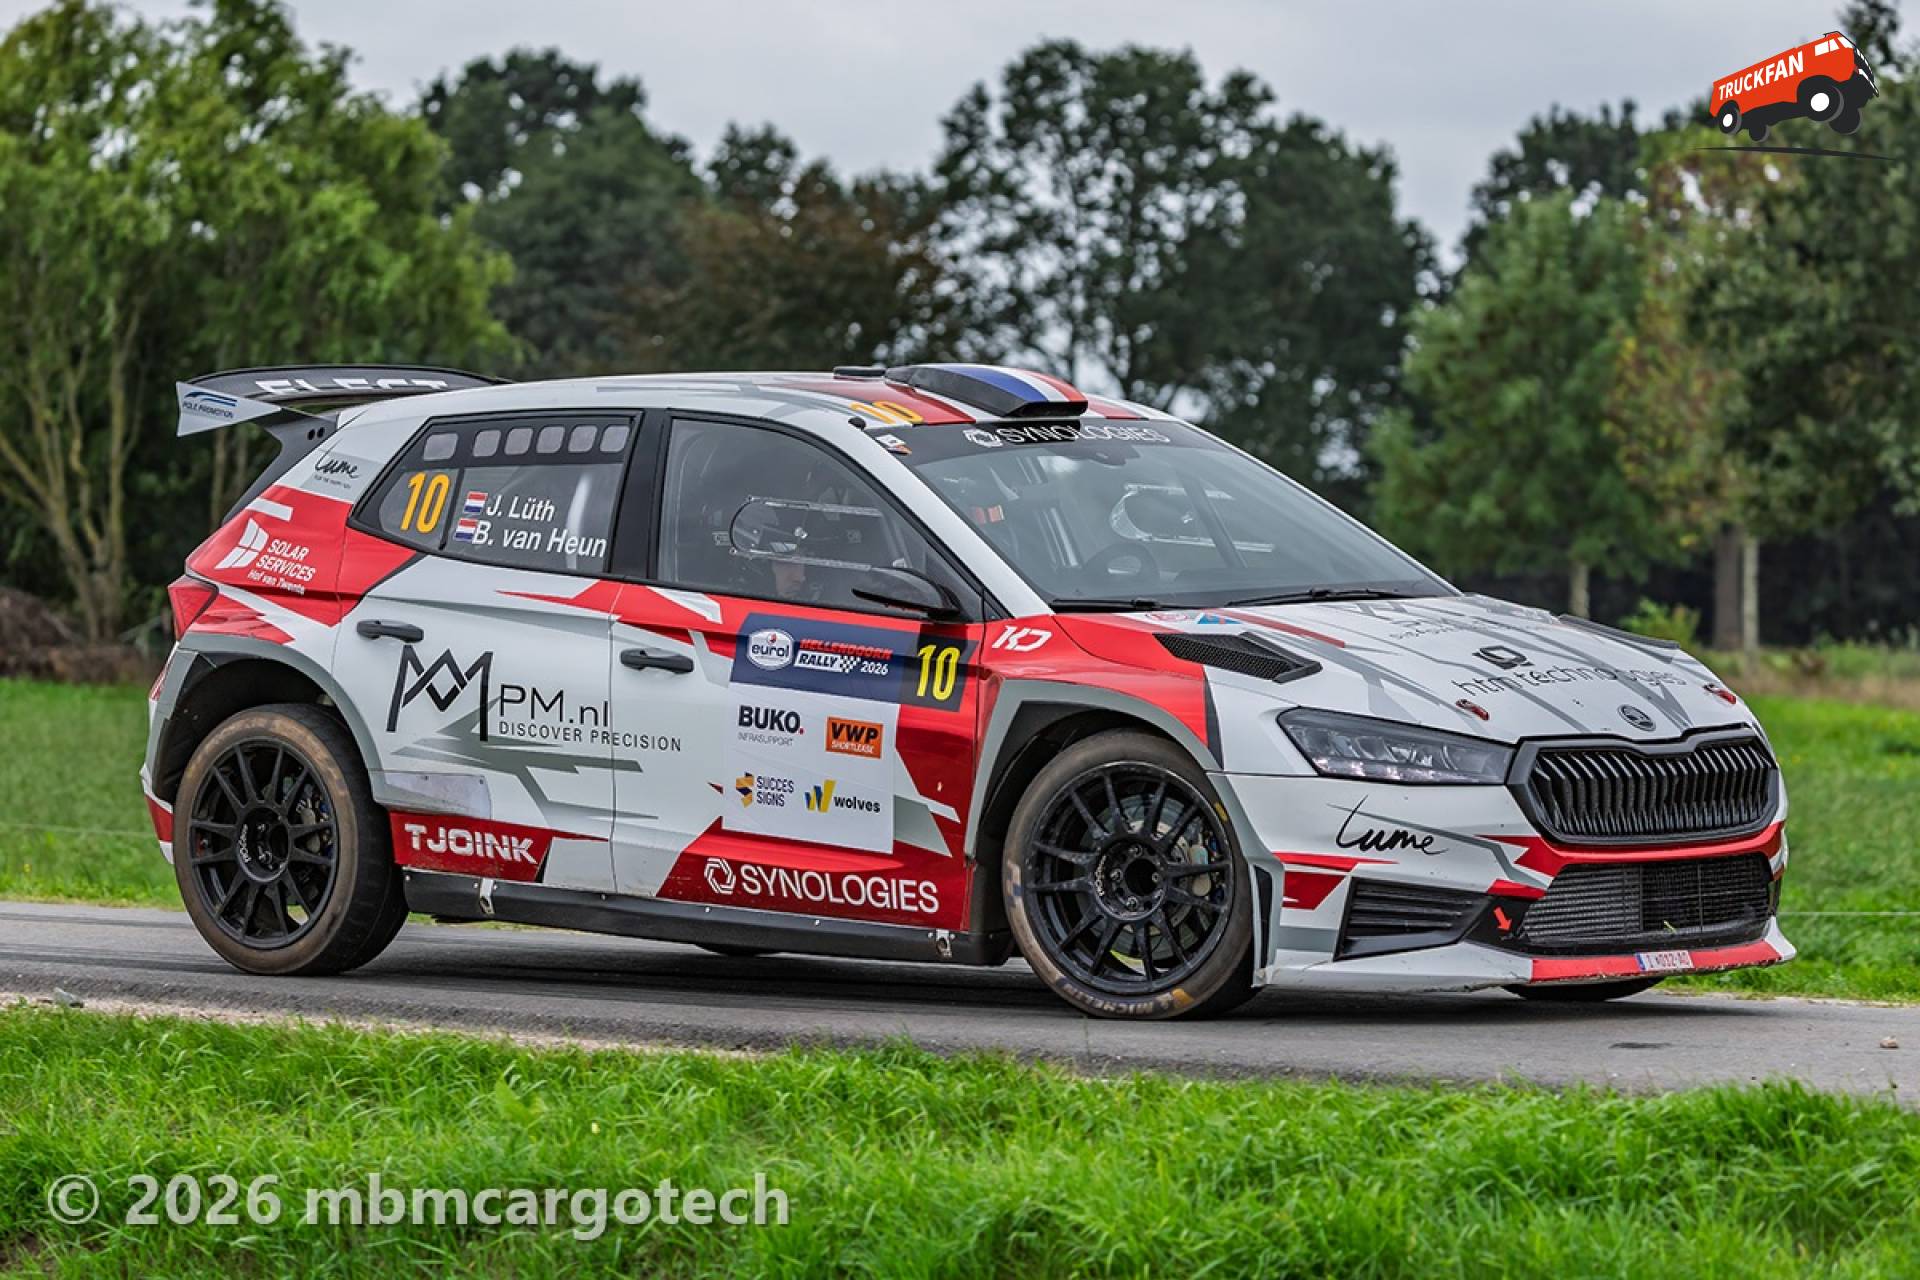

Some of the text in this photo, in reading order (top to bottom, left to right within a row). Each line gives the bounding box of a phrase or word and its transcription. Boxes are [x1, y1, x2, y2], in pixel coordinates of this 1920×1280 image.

[998, 425, 1170, 443] SYNOLOGIES
[400, 471, 450, 534] 10
[486, 494, 556, 521] J. Lüth
[267, 538, 310, 561] SOLAR
[472, 519, 608, 558] B. van Heun
[247, 569, 265, 581] Hof
[262, 575, 277, 586] van
[256, 554, 316, 582] SERVICES
[751, 643, 789, 658] eurol
[800, 639, 894, 660] HELLENDOORN
[799, 653, 839, 668] RALLY
[860, 660, 889, 676] 2026
[916, 644, 961, 701] 10
[499, 721, 682, 752] DISCOVER PRECISION
[831, 722, 879, 744] VWP
[757, 775, 795, 794] SUCCES
[757, 791, 786, 808] SIGNS
[834, 796, 881, 813] wolves
[404, 823, 539, 865] TJOINK
[740, 863, 940, 914] SYNOLOGIES
